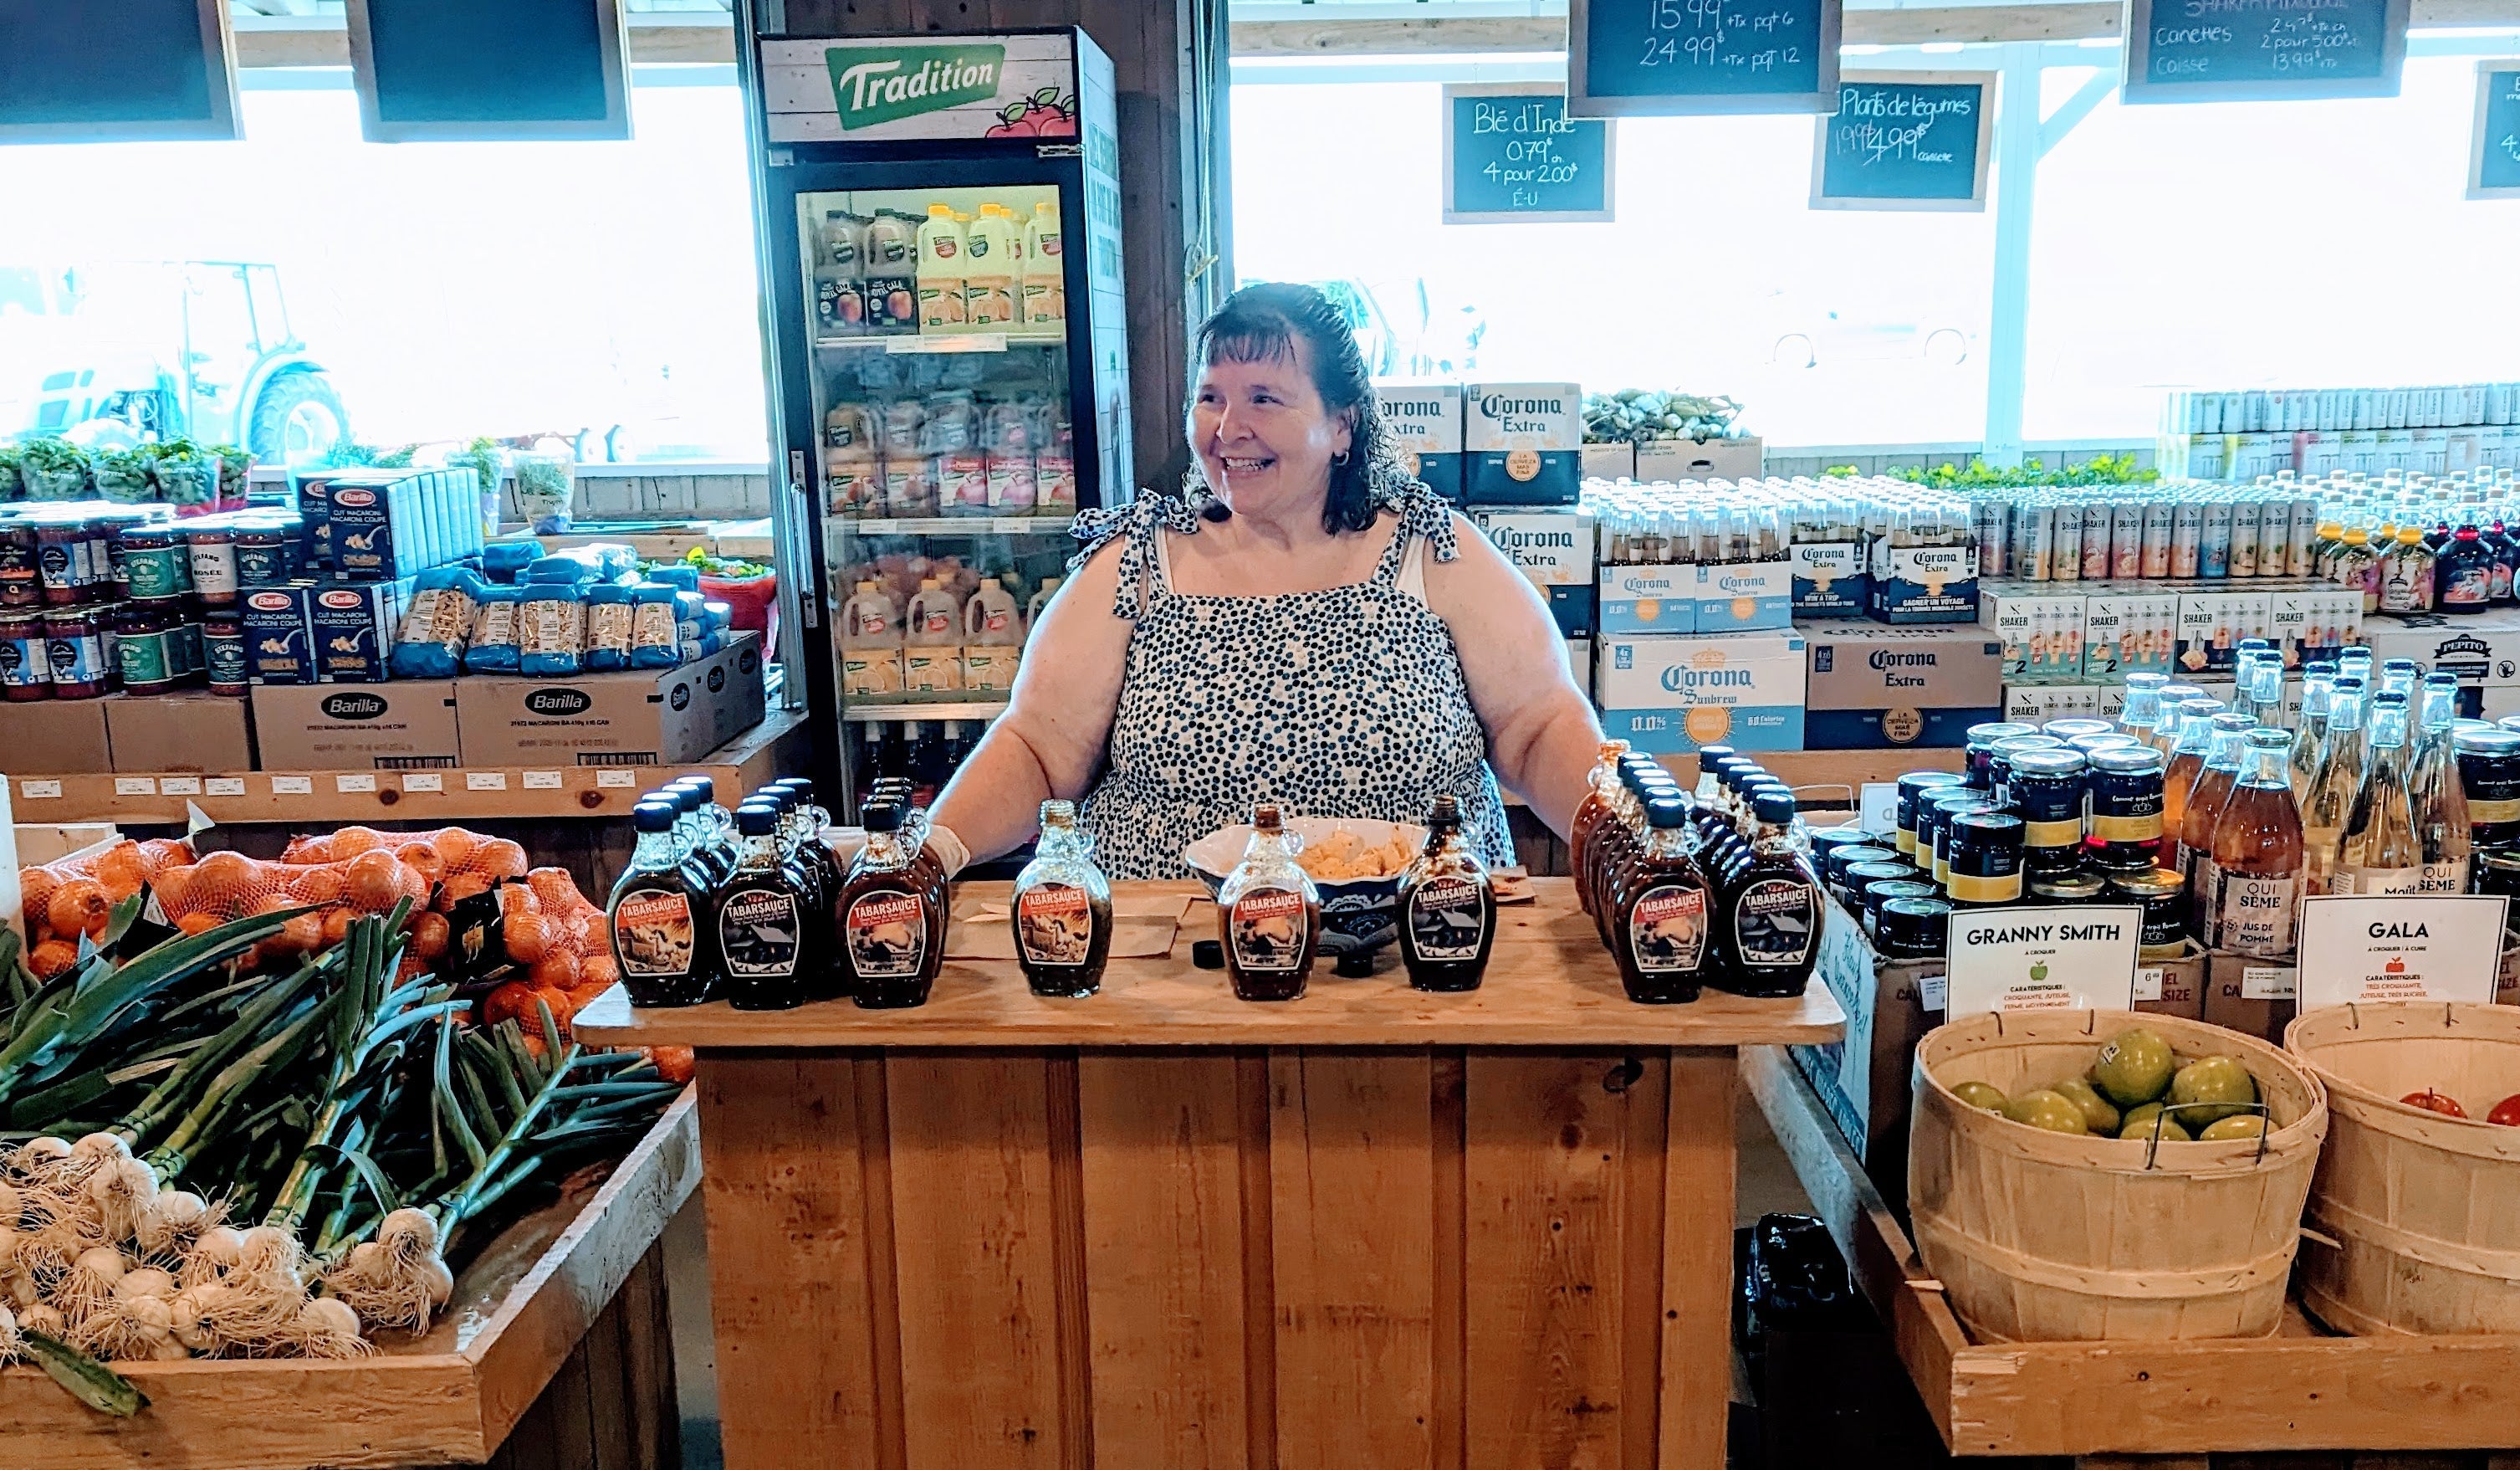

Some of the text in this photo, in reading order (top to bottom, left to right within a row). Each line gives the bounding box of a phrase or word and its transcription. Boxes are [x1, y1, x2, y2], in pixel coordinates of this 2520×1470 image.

[1782, 11, 1794, 25] 6
[2155, 26, 2232, 46] Canettes
[2260, 34, 2272, 49] 2
[2274, 38, 2307, 49] pour
[1782, 46, 1801, 63] 12
[2155, 55, 2210, 75] Caisse
[840, 57, 993, 111] Tradition
[1843, 89, 1971, 129] Plants de légumes
[1474, 102, 1576, 135] Blé d'Inde
[1483, 160, 1501, 182] 4
[1503, 168, 1536, 186] pour
[1512, 187, 1539, 207] É-U
[1383, 399, 1442, 417] orona
[1480, 393, 1563, 421] Corona
[1503, 417, 1546, 433] Extra
[344, 492, 374, 503] Barilla
[1489, 526, 1574, 554] Corona
[1512, 550, 1557, 566] Extra
[1802, 548, 1845, 562] Corona
[1913, 551, 1957, 566] Corona
[1812, 560, 1837, 568] Extra
[1925, 564, 1949, 572] Extra
[1624, 576, 1670, 592] Corona
[1720, 576, 1766, 592] Corona
[258, 596, 289, 607] Barilla
[328, 595, 360, 605] Barilla
[314, 617, 349, 626] MACARONI
[2000, 617, 2028, 627] SHAKER
[2090, 616, 2119, 626] SHAKER
[2184, 613, 2212, 623] SHAKER
[2275, 612, 2304, 622] SHAKER
[2443, 640, 2484, 653] PEPITO
[1869, 649, 1936, 672] Corona
[2015, 659, 2027, 674] 2
[2104, 658, 2117, 674] 2
[1660, 664, 1752, 694] Corona
[1885, 673, 1925, 687] Extra
[534, 694, 583, 709] Barilla
[1683, 689, 1737, 704] Sunbrew
[330, 698, 381, 713] Barilla
[2011, 706, 2039, 716] SHAKER
[2103, 705, 2124, 716] SHAK
[1632, 716, 1667, 732] 0.0%
[2422, 867, 2451, 879] QUI
[1418, 887, 1479, 904] TABARSAUCE
[1746, 888, 1808, 907] TABARSAUCE
[2247, 882, 2276, 897] QUI
[1025, 890, 1082, 908] TABARSAUCE
[1240, 893, 1301, 913] TABARSAUCE
[1639, 894, 1701, 914] TABARSAUCE
[621, 899, 684, 919] TABARSAUCE
[727, 899, 790, 919] TABARSAUCE
[854, 898, 918, 919] TABARSAUCE
[2242, 922, 2273, 931] JUS DE
[2369, 922, 2429, 939] GALA
[1967, 925, 2120, 946] GRANNY SMITH
[2240, 935, 2275, 944] POMME
[2163, 989, 2190, 1001] SIZE
